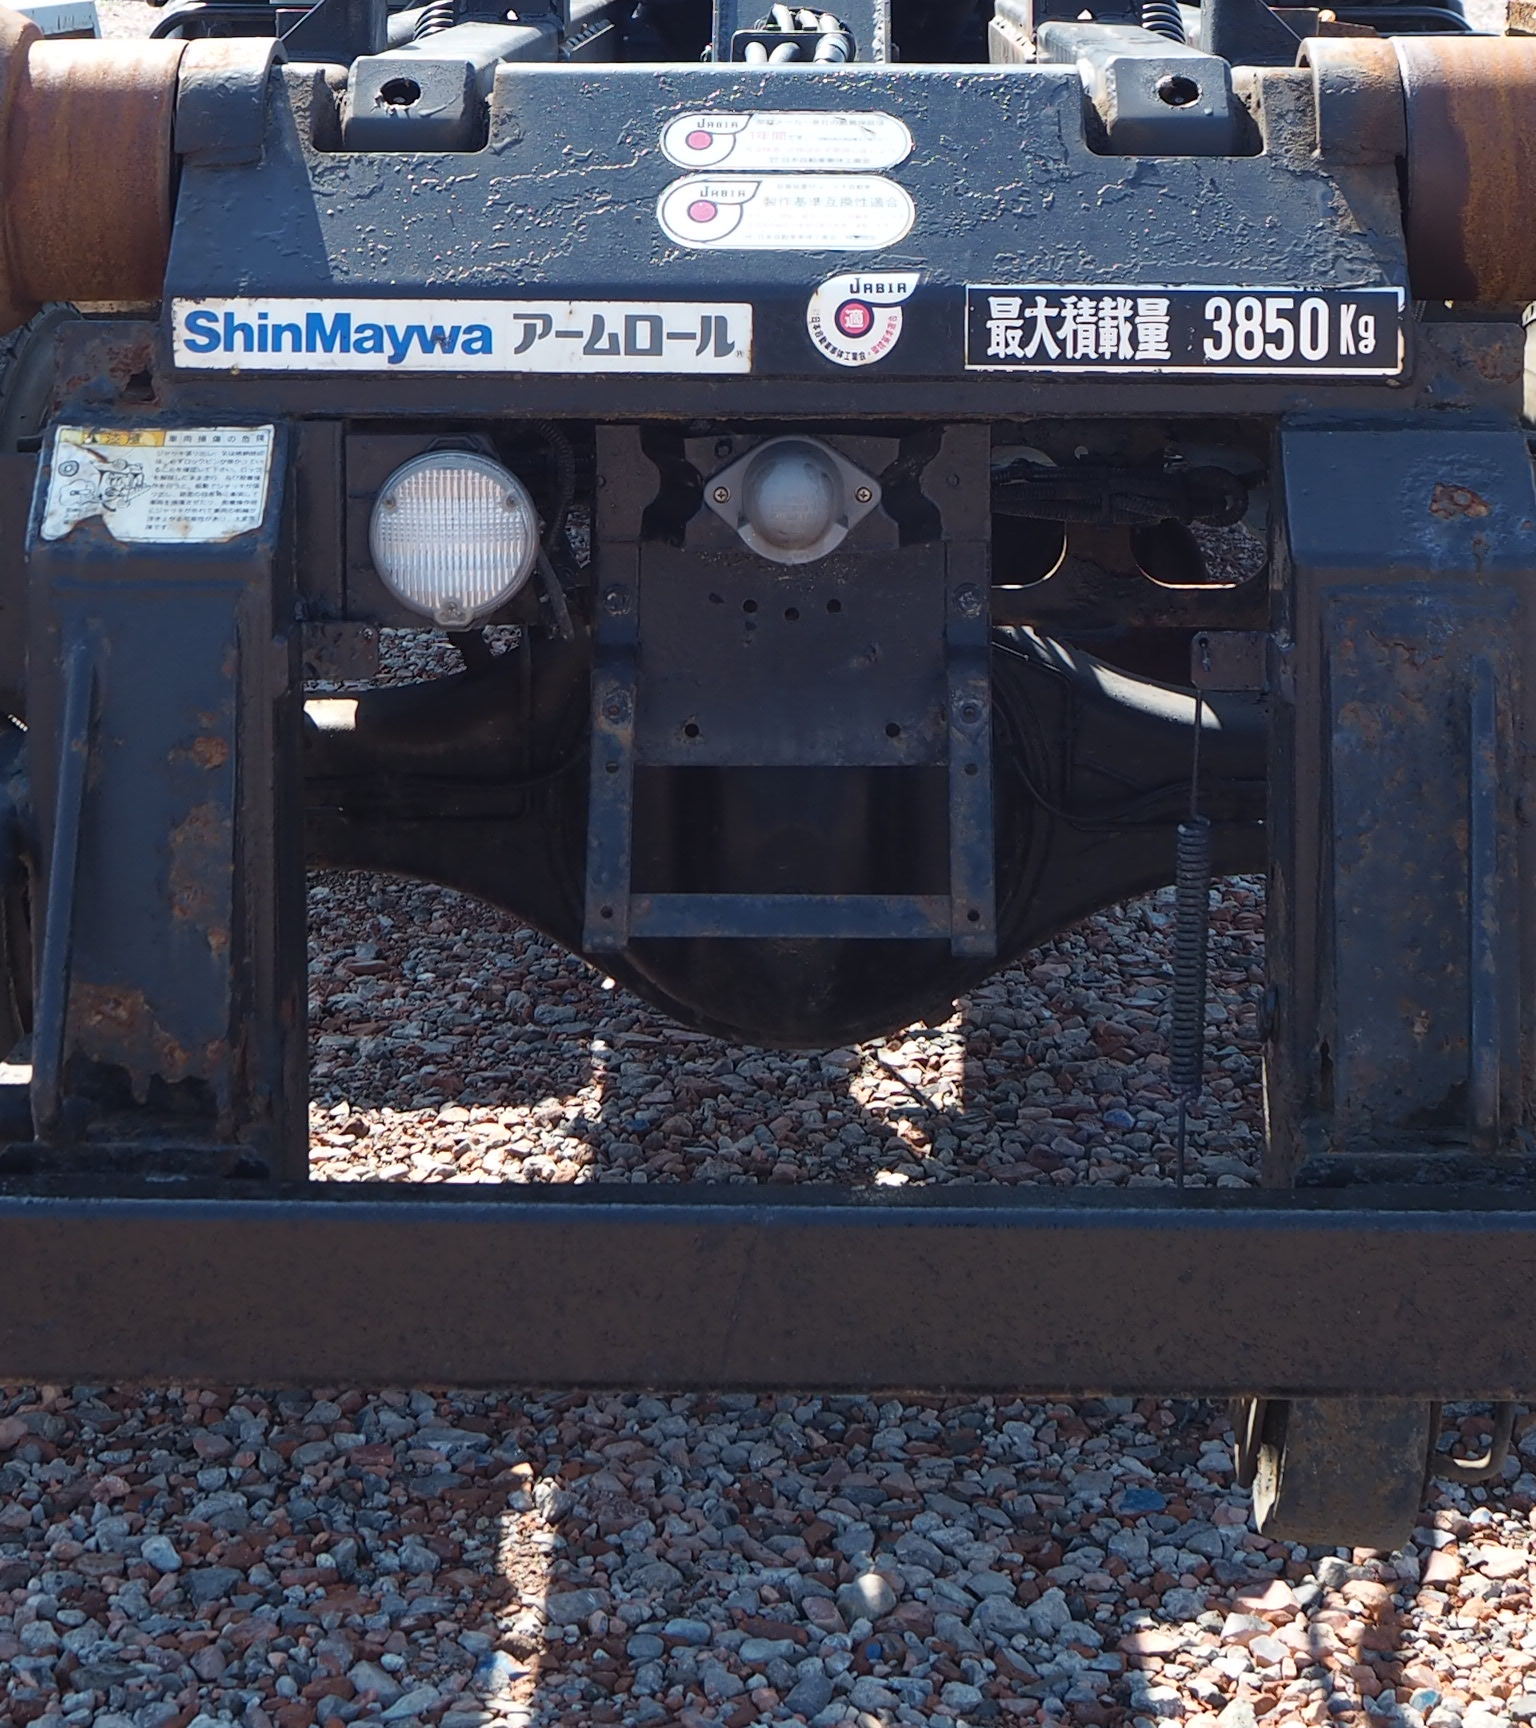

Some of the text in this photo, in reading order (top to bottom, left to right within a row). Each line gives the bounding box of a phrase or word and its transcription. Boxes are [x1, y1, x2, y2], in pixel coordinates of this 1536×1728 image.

[700, 185, 746, 198] JABIA
[849, 277, 907, 294] JABIA
[182, 309, 735, 364] ShinMaywa アームロール
[985, 295, 1172, 360] 最大積載量
